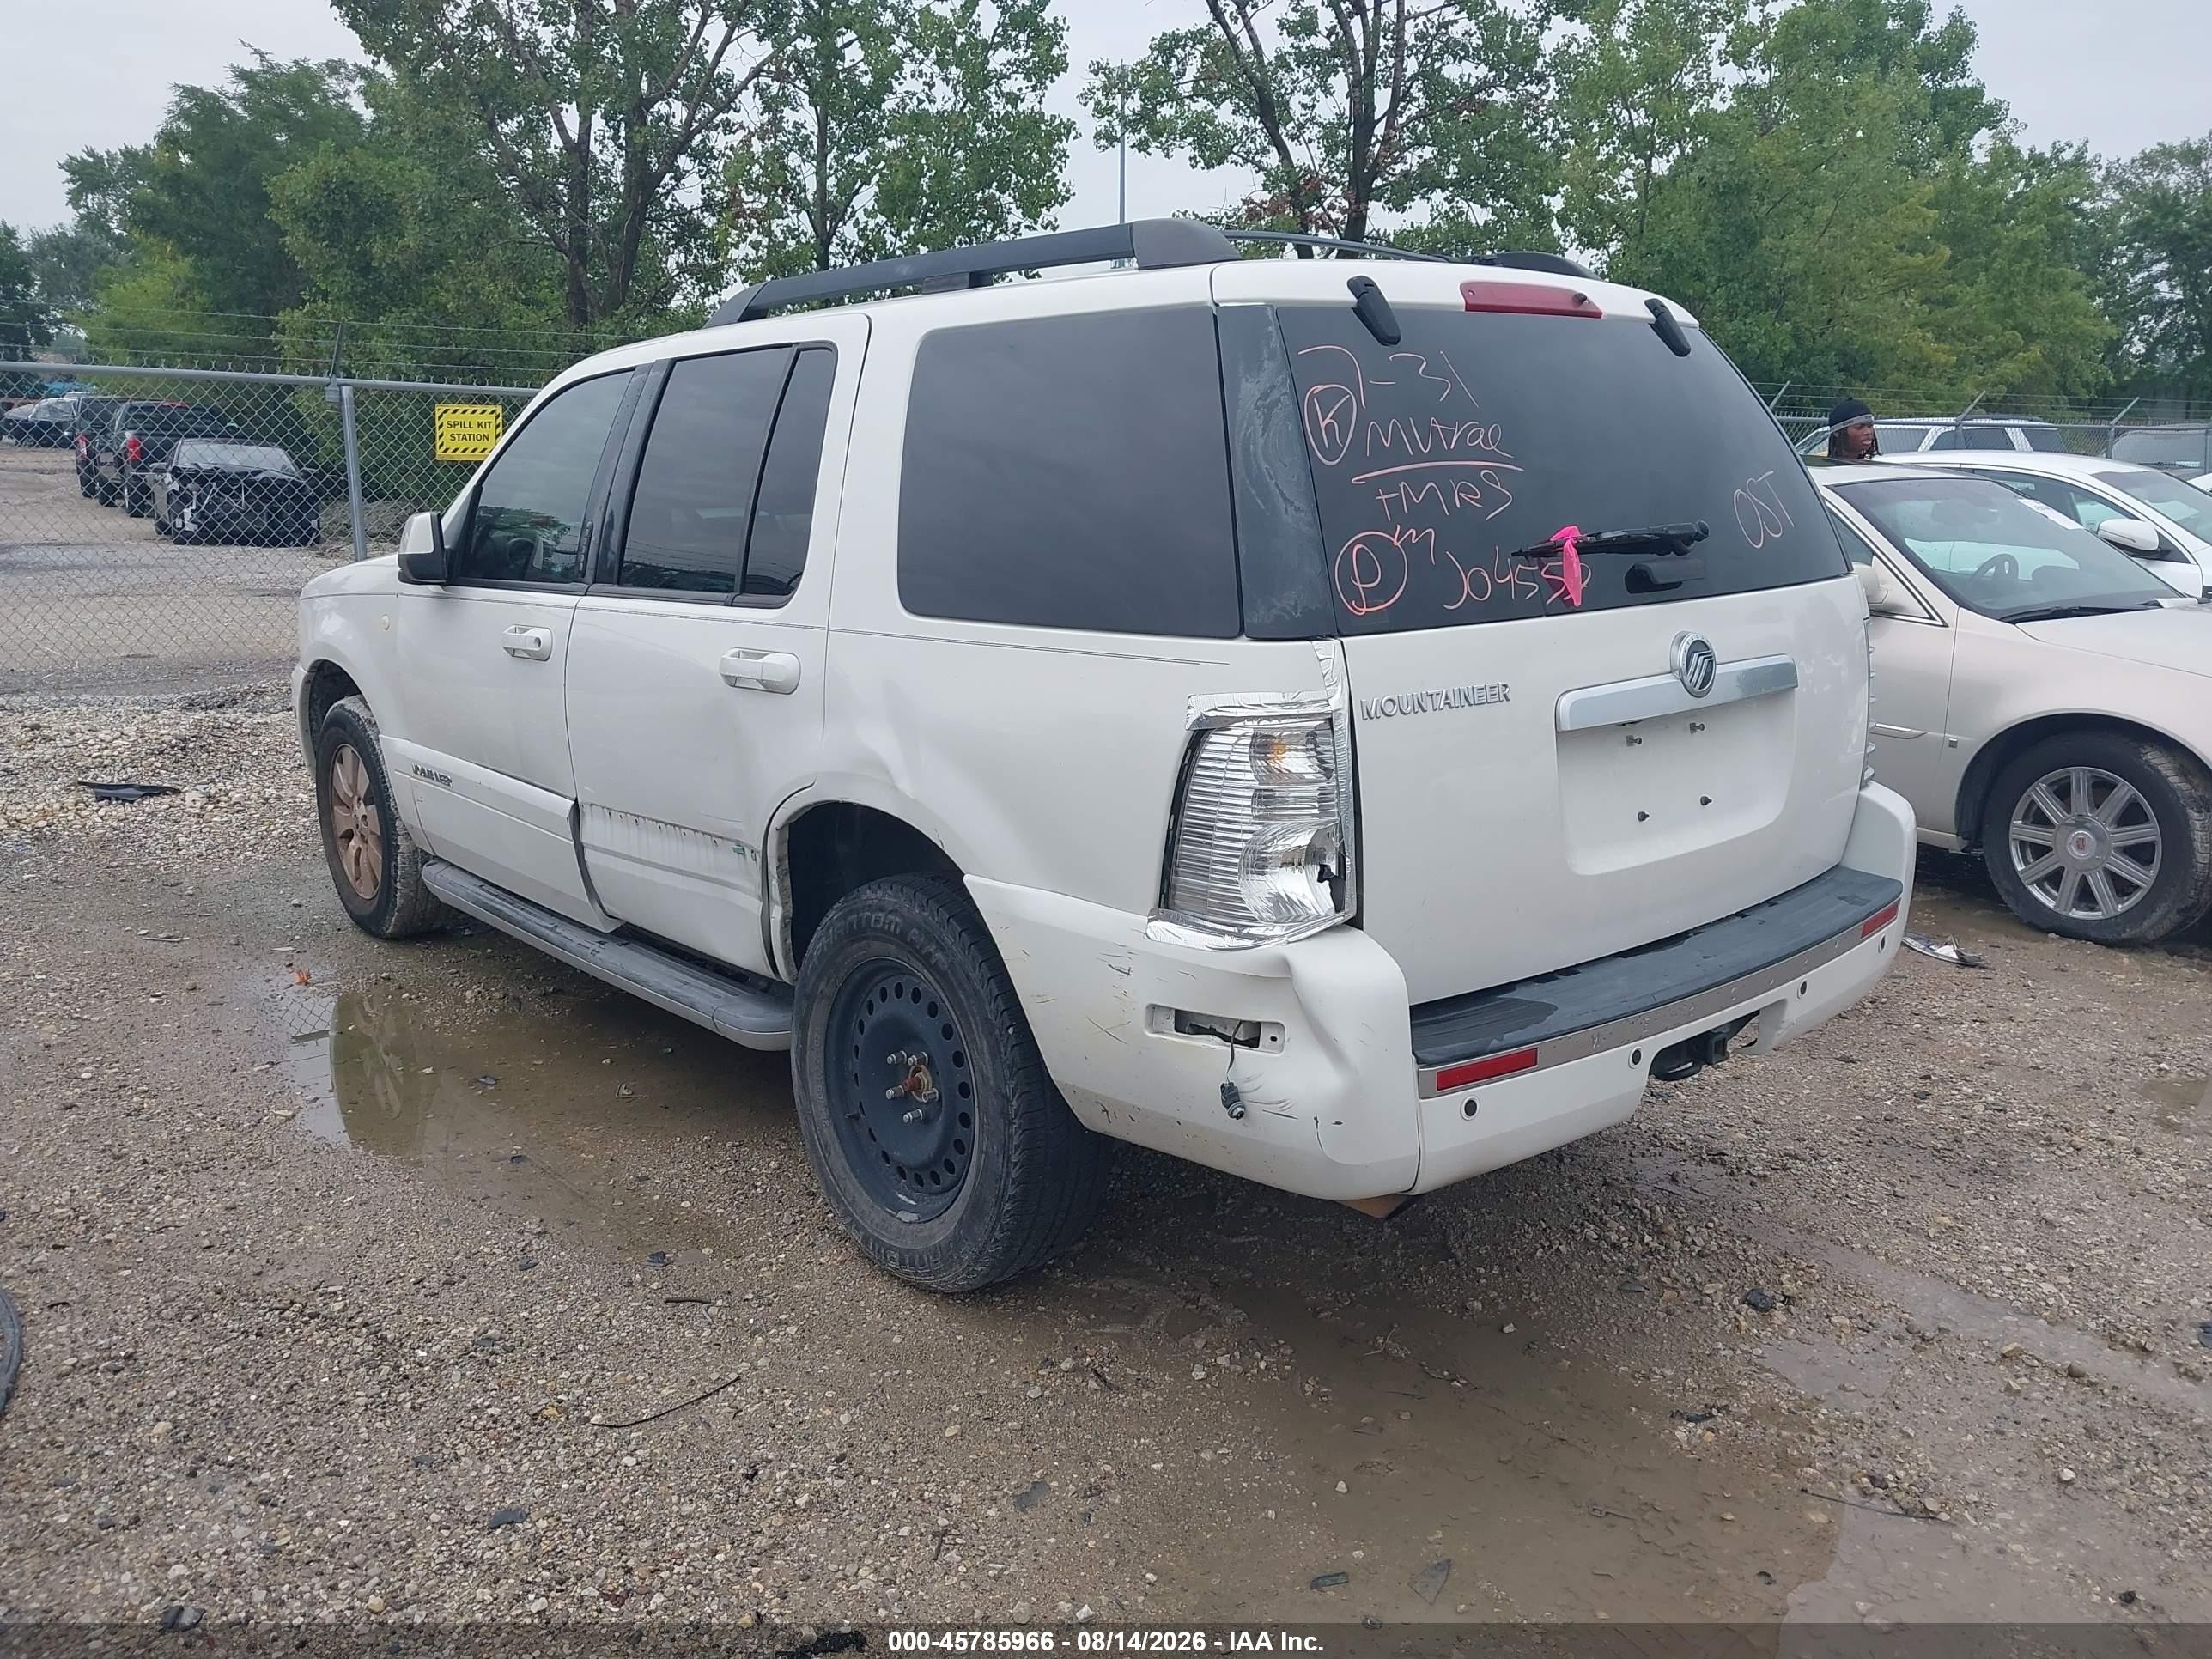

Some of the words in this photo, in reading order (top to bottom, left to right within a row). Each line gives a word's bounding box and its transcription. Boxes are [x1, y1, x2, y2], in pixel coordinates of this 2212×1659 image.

[446, 420, 474, 429] SPILL
[477, 420, 493, 429] KIT
[449, 433, 490, 442] STATION
[1359, 680, 1511, 721] MOUNTAINEER
